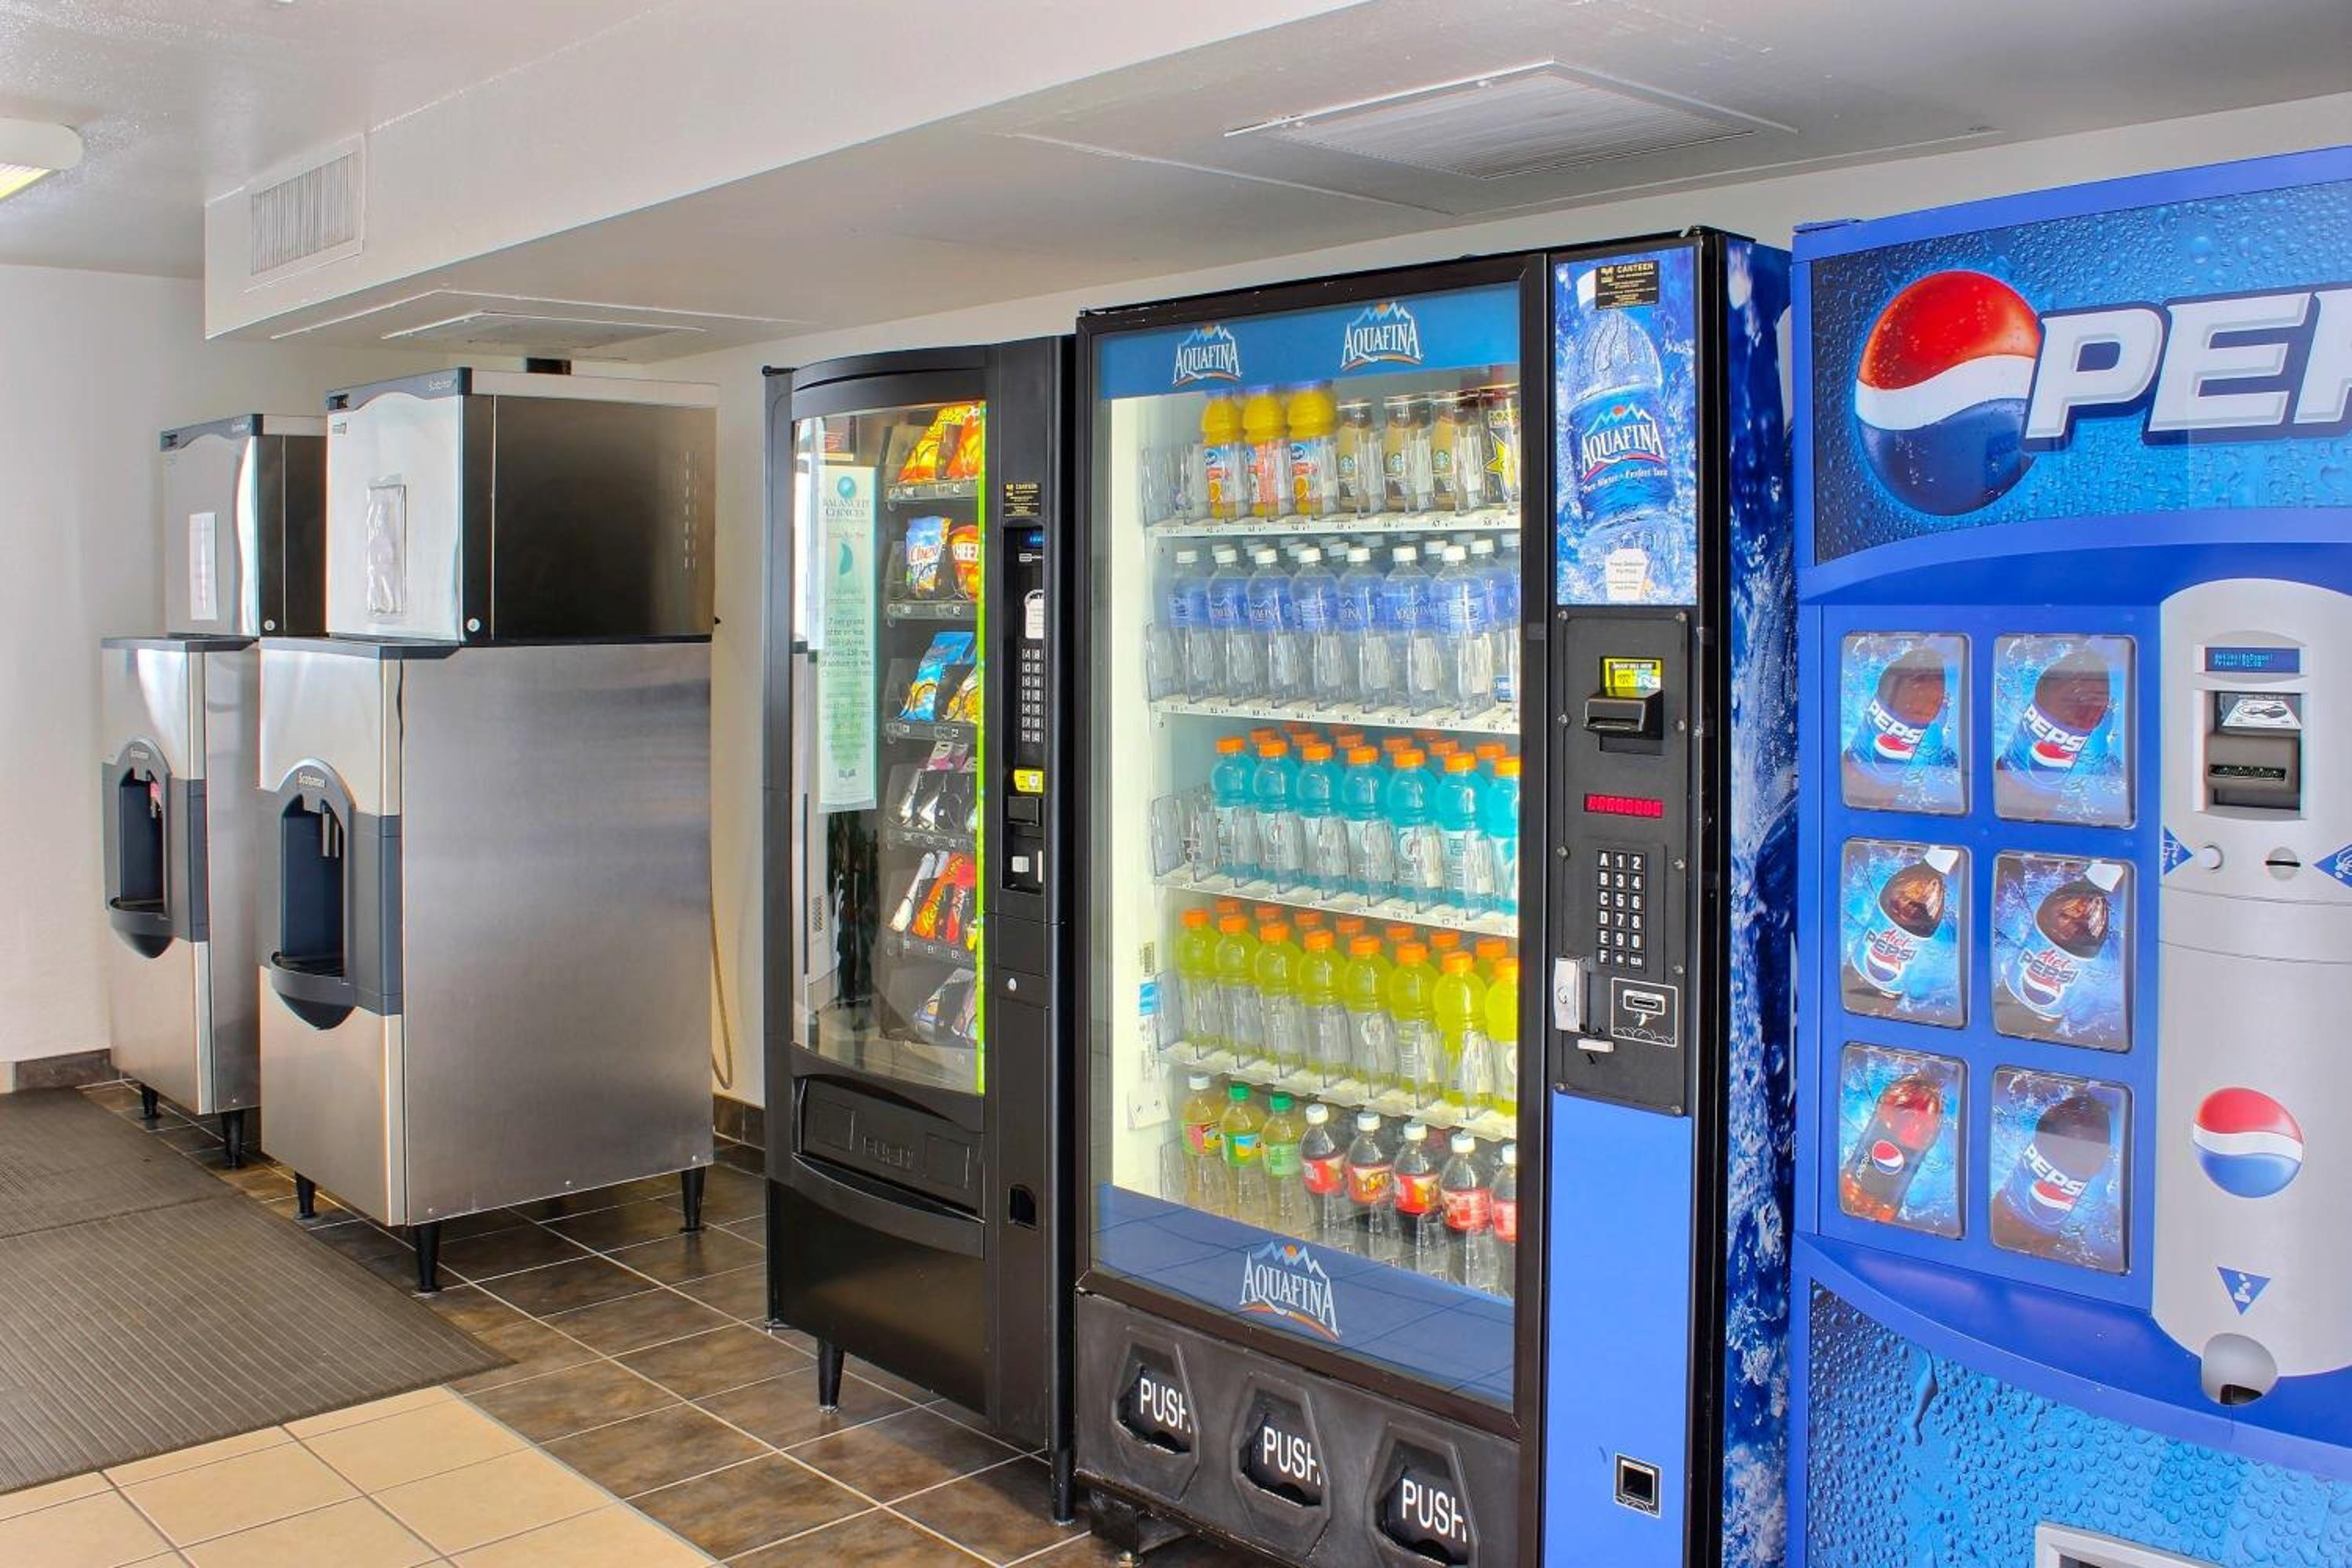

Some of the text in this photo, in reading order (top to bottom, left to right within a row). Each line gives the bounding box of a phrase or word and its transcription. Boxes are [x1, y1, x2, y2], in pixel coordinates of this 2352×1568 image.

[1616, 263, 1654, 274] CANTEEN
[1340, 315, 1422, 368] AQUAFINA
[1172, 337, 1242, 385] AQUAFINA
[1581, 418, 1664, 480] AQUAFINA
[1600, 853, 1641, 869] A 1 2
[1600, 872, 1640, 889] B 3 4
[1600, 891, 1640, 909] C 5 6
[1600, 910, 1640, 928] D 7 8
[1600, 931, 1640, 948] E 9 0
[1865, 930, 1918, 961] PEPSI
[1600, 949, 1607, 963] F
[2020, 950, 2080, 984] PEPSI
[1240, 1250, 1340, 1338] AQUAFINA
